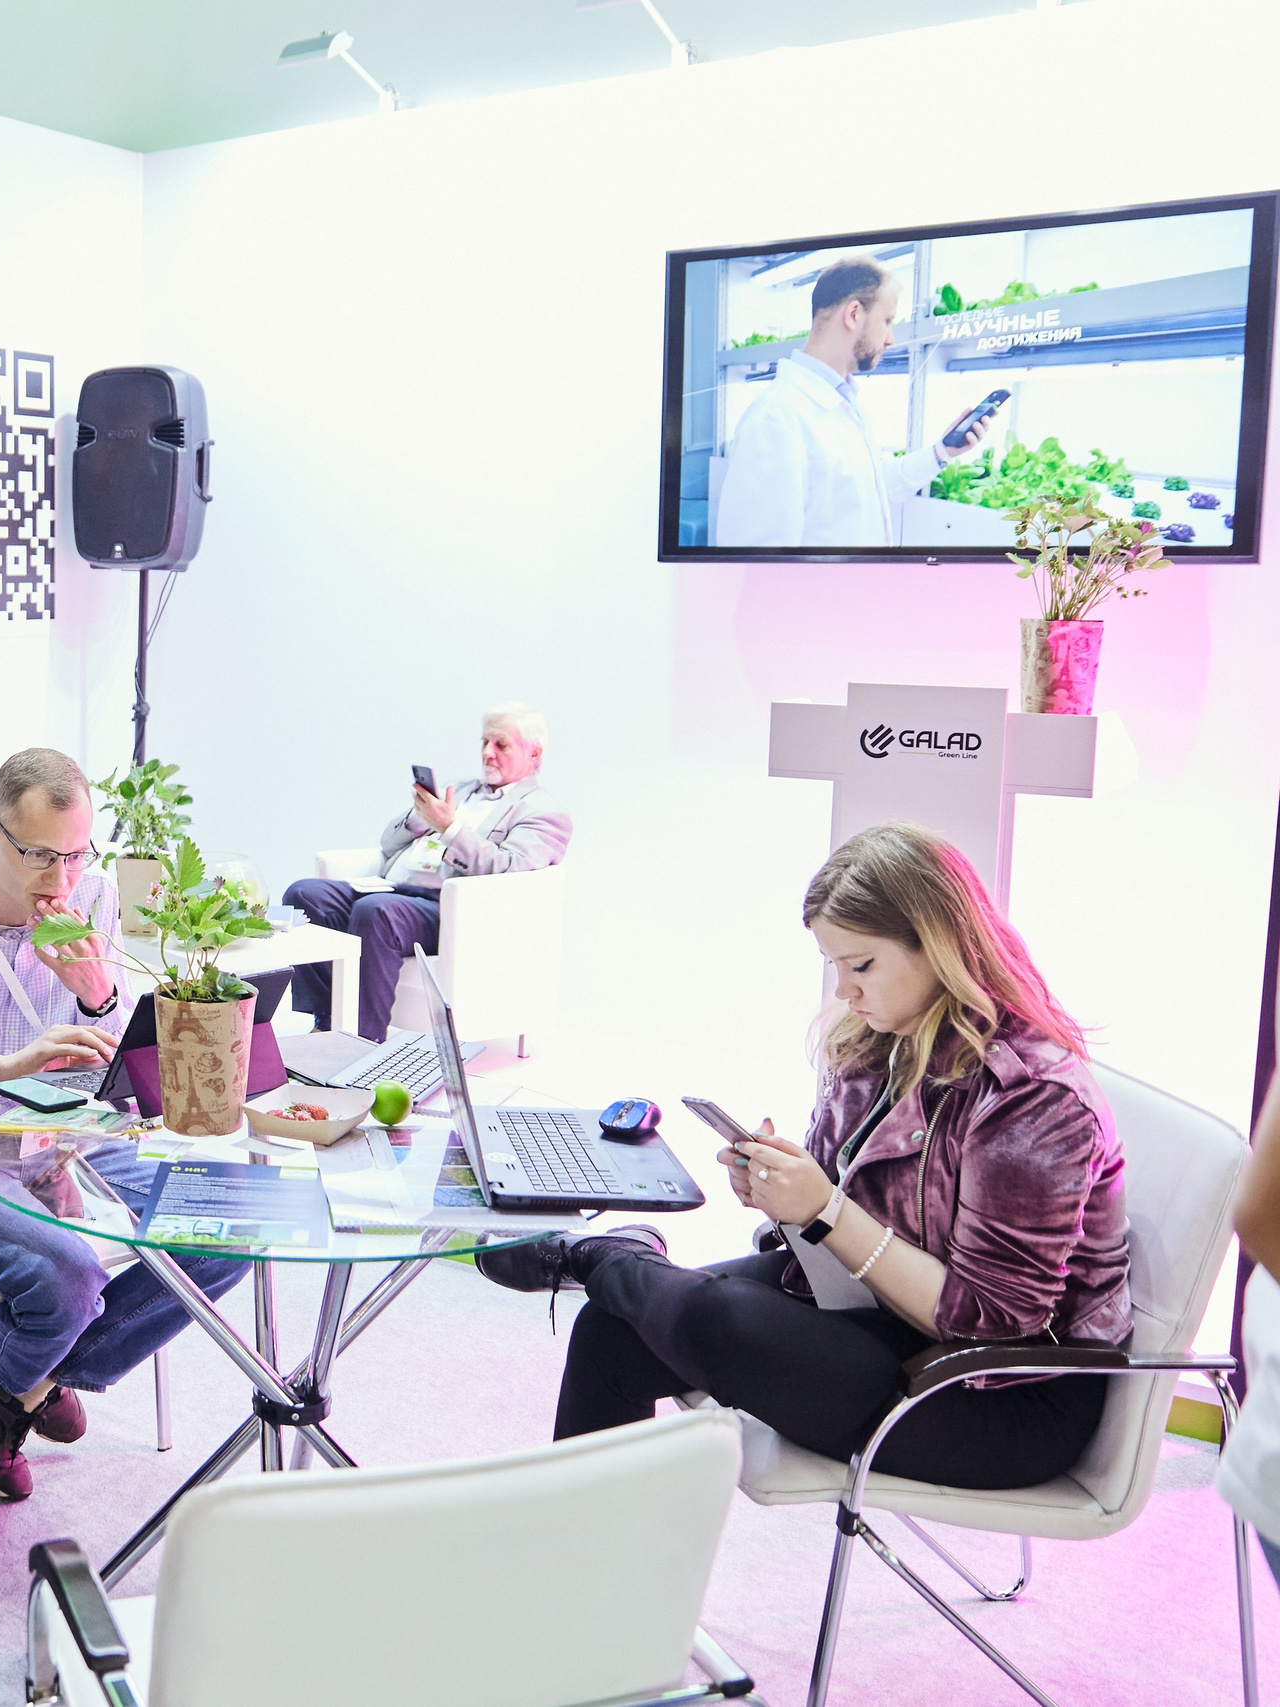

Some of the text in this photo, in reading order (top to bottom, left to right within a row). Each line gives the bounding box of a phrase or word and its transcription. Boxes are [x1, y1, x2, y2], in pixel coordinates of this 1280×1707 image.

[935, 306, 1005, 326] ПОСЛЕДНИЕ
[942, 309, 1061, 340] НАУЧНЫЕ
[976, 327, 1082, 351] ДОСТИЖЕНИЯ
[898, 730, 982, 751] GALAD
